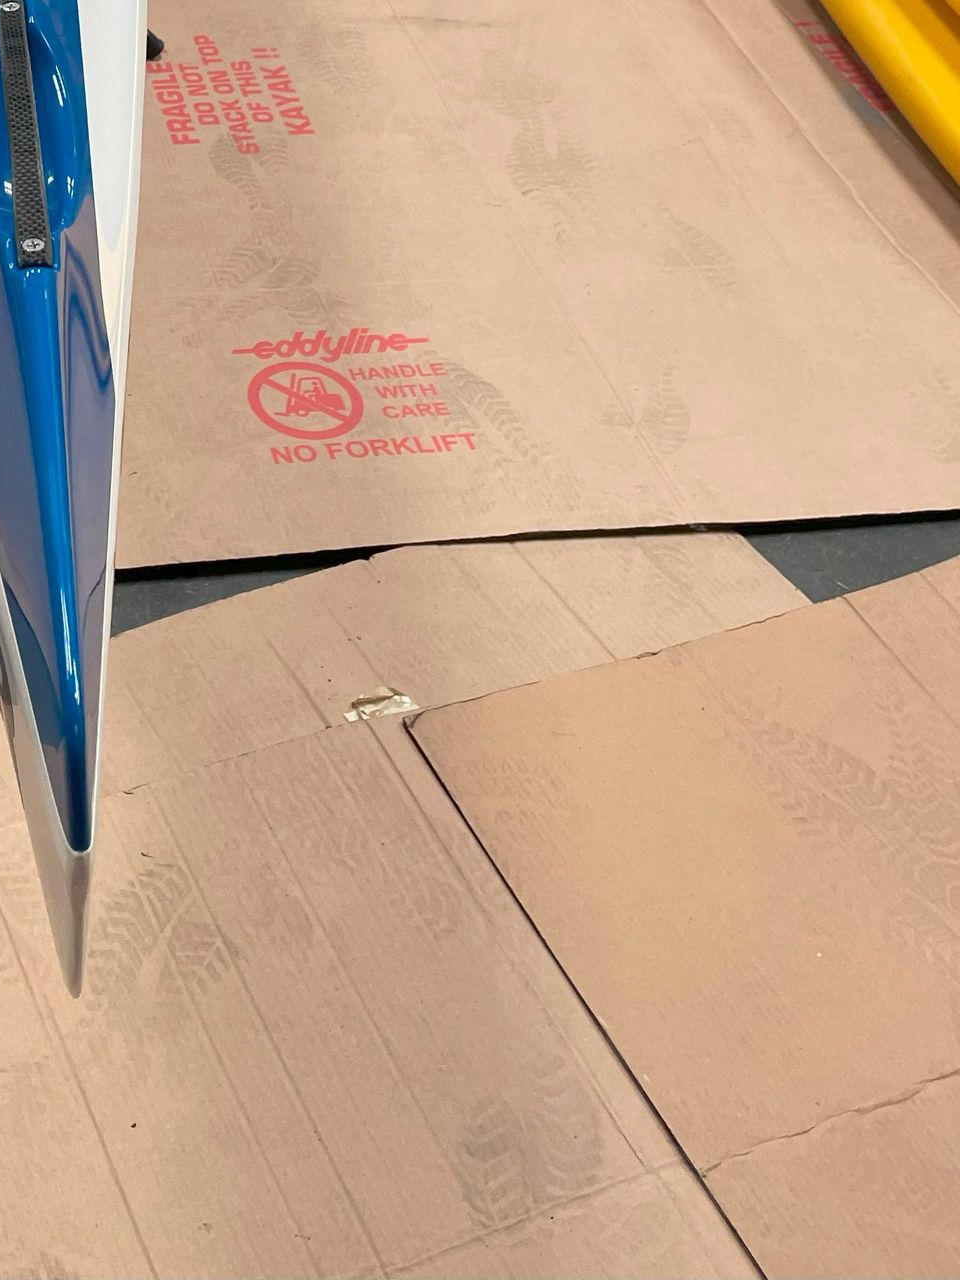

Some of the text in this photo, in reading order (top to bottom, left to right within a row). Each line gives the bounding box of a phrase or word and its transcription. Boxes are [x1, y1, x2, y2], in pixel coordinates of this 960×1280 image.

[146, 62, 201, 146] FRAGILE
[178, 63, 221, 126] DO NOT
[193, 35, 261, 155] STACK ON TOP
[230, 60, 274, 123] OF THIS
[259, 65, 315, 136] KAYAK
[231, 328, 430, 363] eddyline
[348, 362, 448, 381] HANDLE
[375, 383, 437, 399] WITH
[382, 402, 451, 419] CARE
[269, 432, 478, 464] NO FORKLIFT
